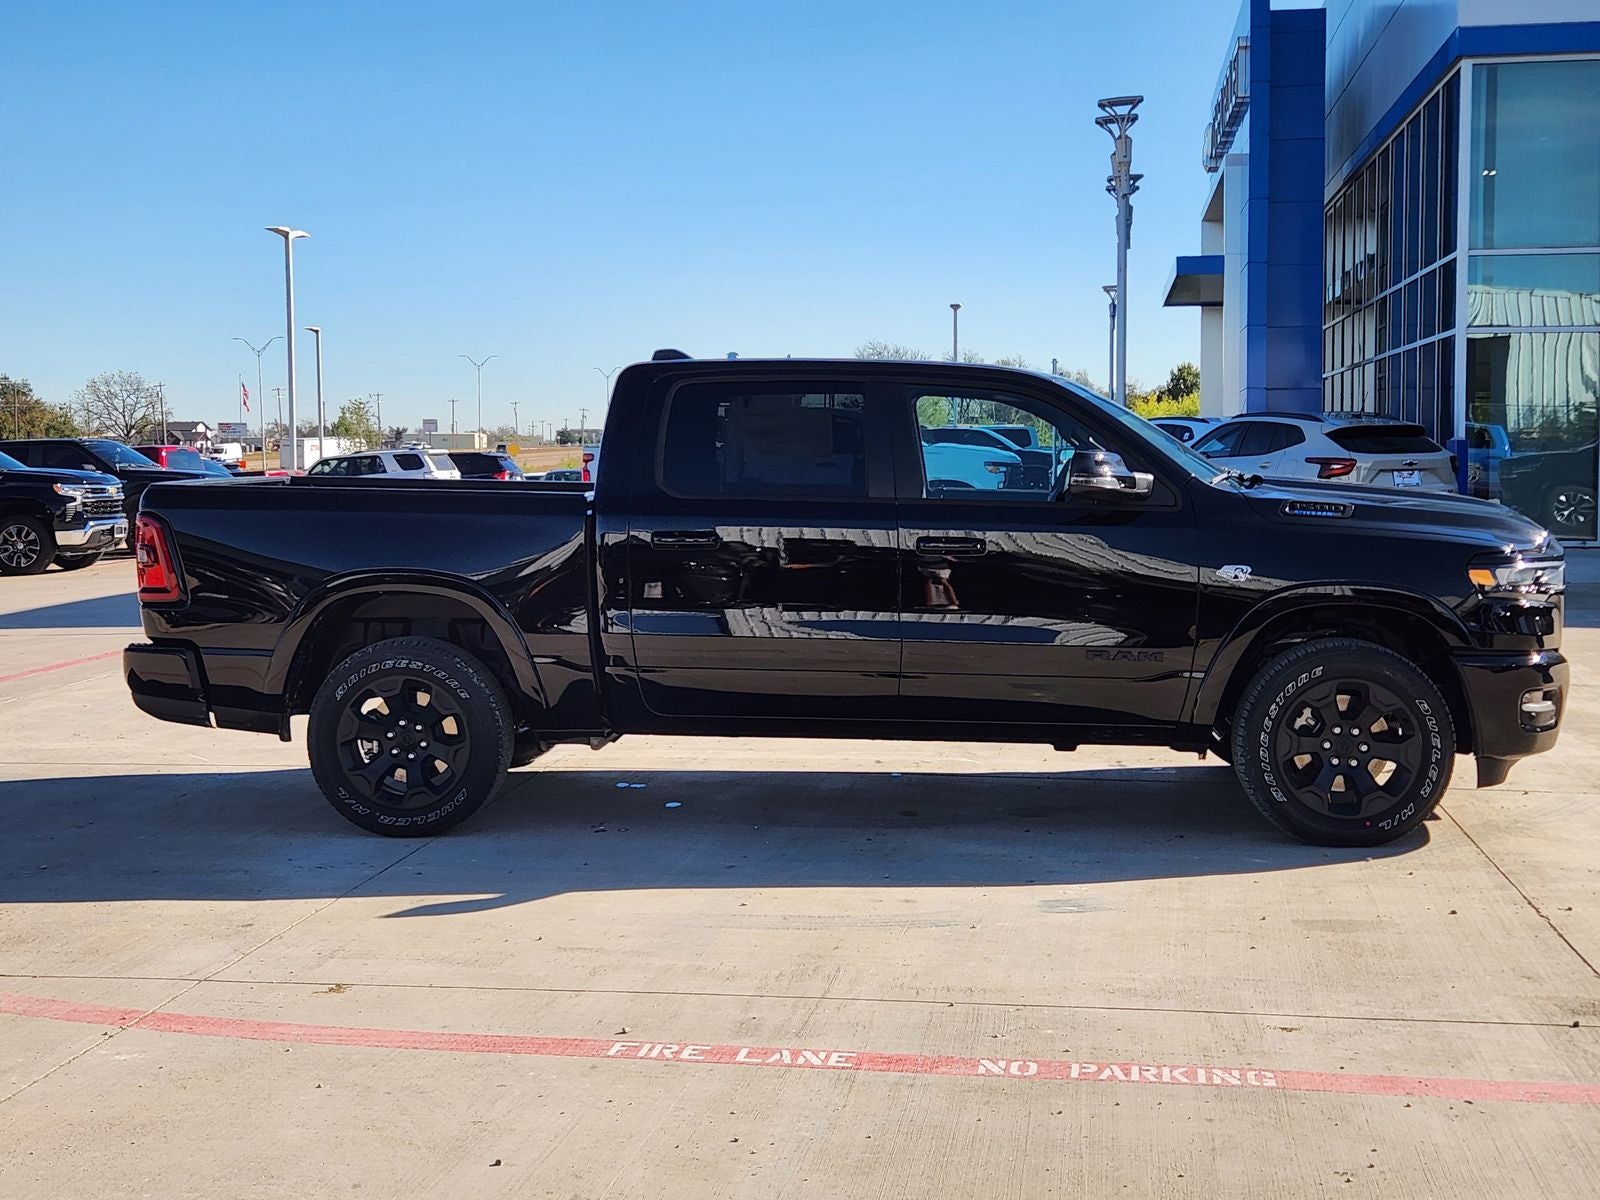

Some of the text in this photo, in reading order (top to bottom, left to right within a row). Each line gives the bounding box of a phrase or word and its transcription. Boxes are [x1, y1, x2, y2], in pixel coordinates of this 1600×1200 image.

[1085, 649, 1164, 662] RAM
[335, 659, 471, 701] BRIDGESTONE
[1259, 666, 1324, 803] BRIDGESTONE
[1378, 699, 1442, 831] DUELER H/L
[378, 788, 468, 826] DUELER
[606, 1042, 857, 1067] FIRE LANE
[977, 1058, 1278, 1088] NO PARKING
